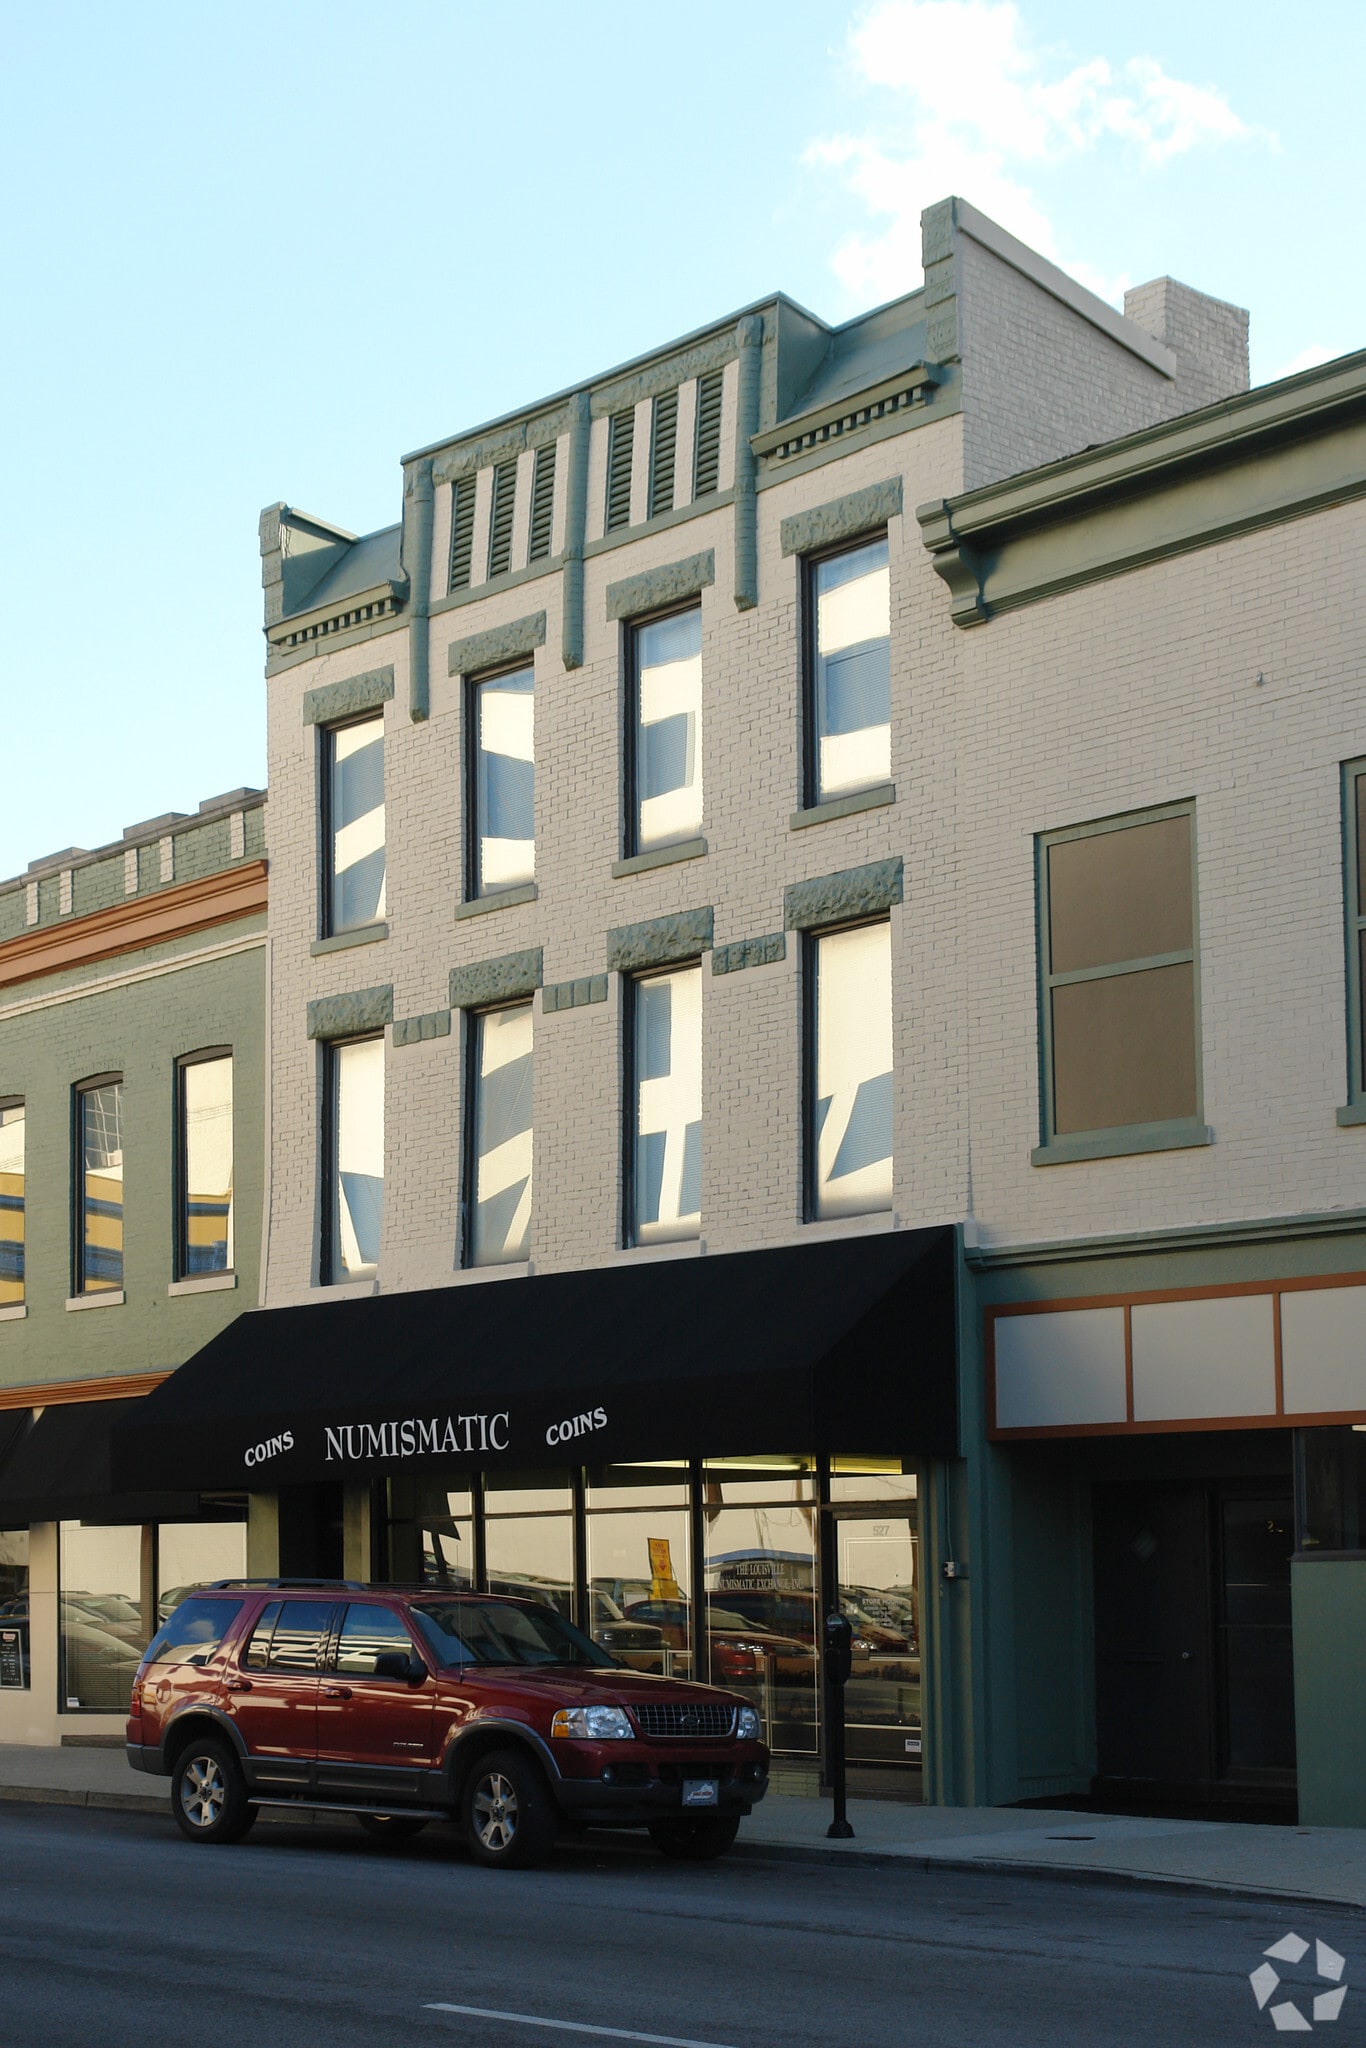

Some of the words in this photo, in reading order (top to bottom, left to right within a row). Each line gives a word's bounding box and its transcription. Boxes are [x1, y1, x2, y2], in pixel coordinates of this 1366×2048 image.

[325, 1412, 509, 1460] NUMISMATIC
[546, 1407, 607, 1445] COINS
[245, 1431, 294, 1466] COINS
[872, 1524, 890, 1536] 527
[735, 1564, 749, 1575] THE
[750, 1563, 785, 1575] LOUISVILLE
